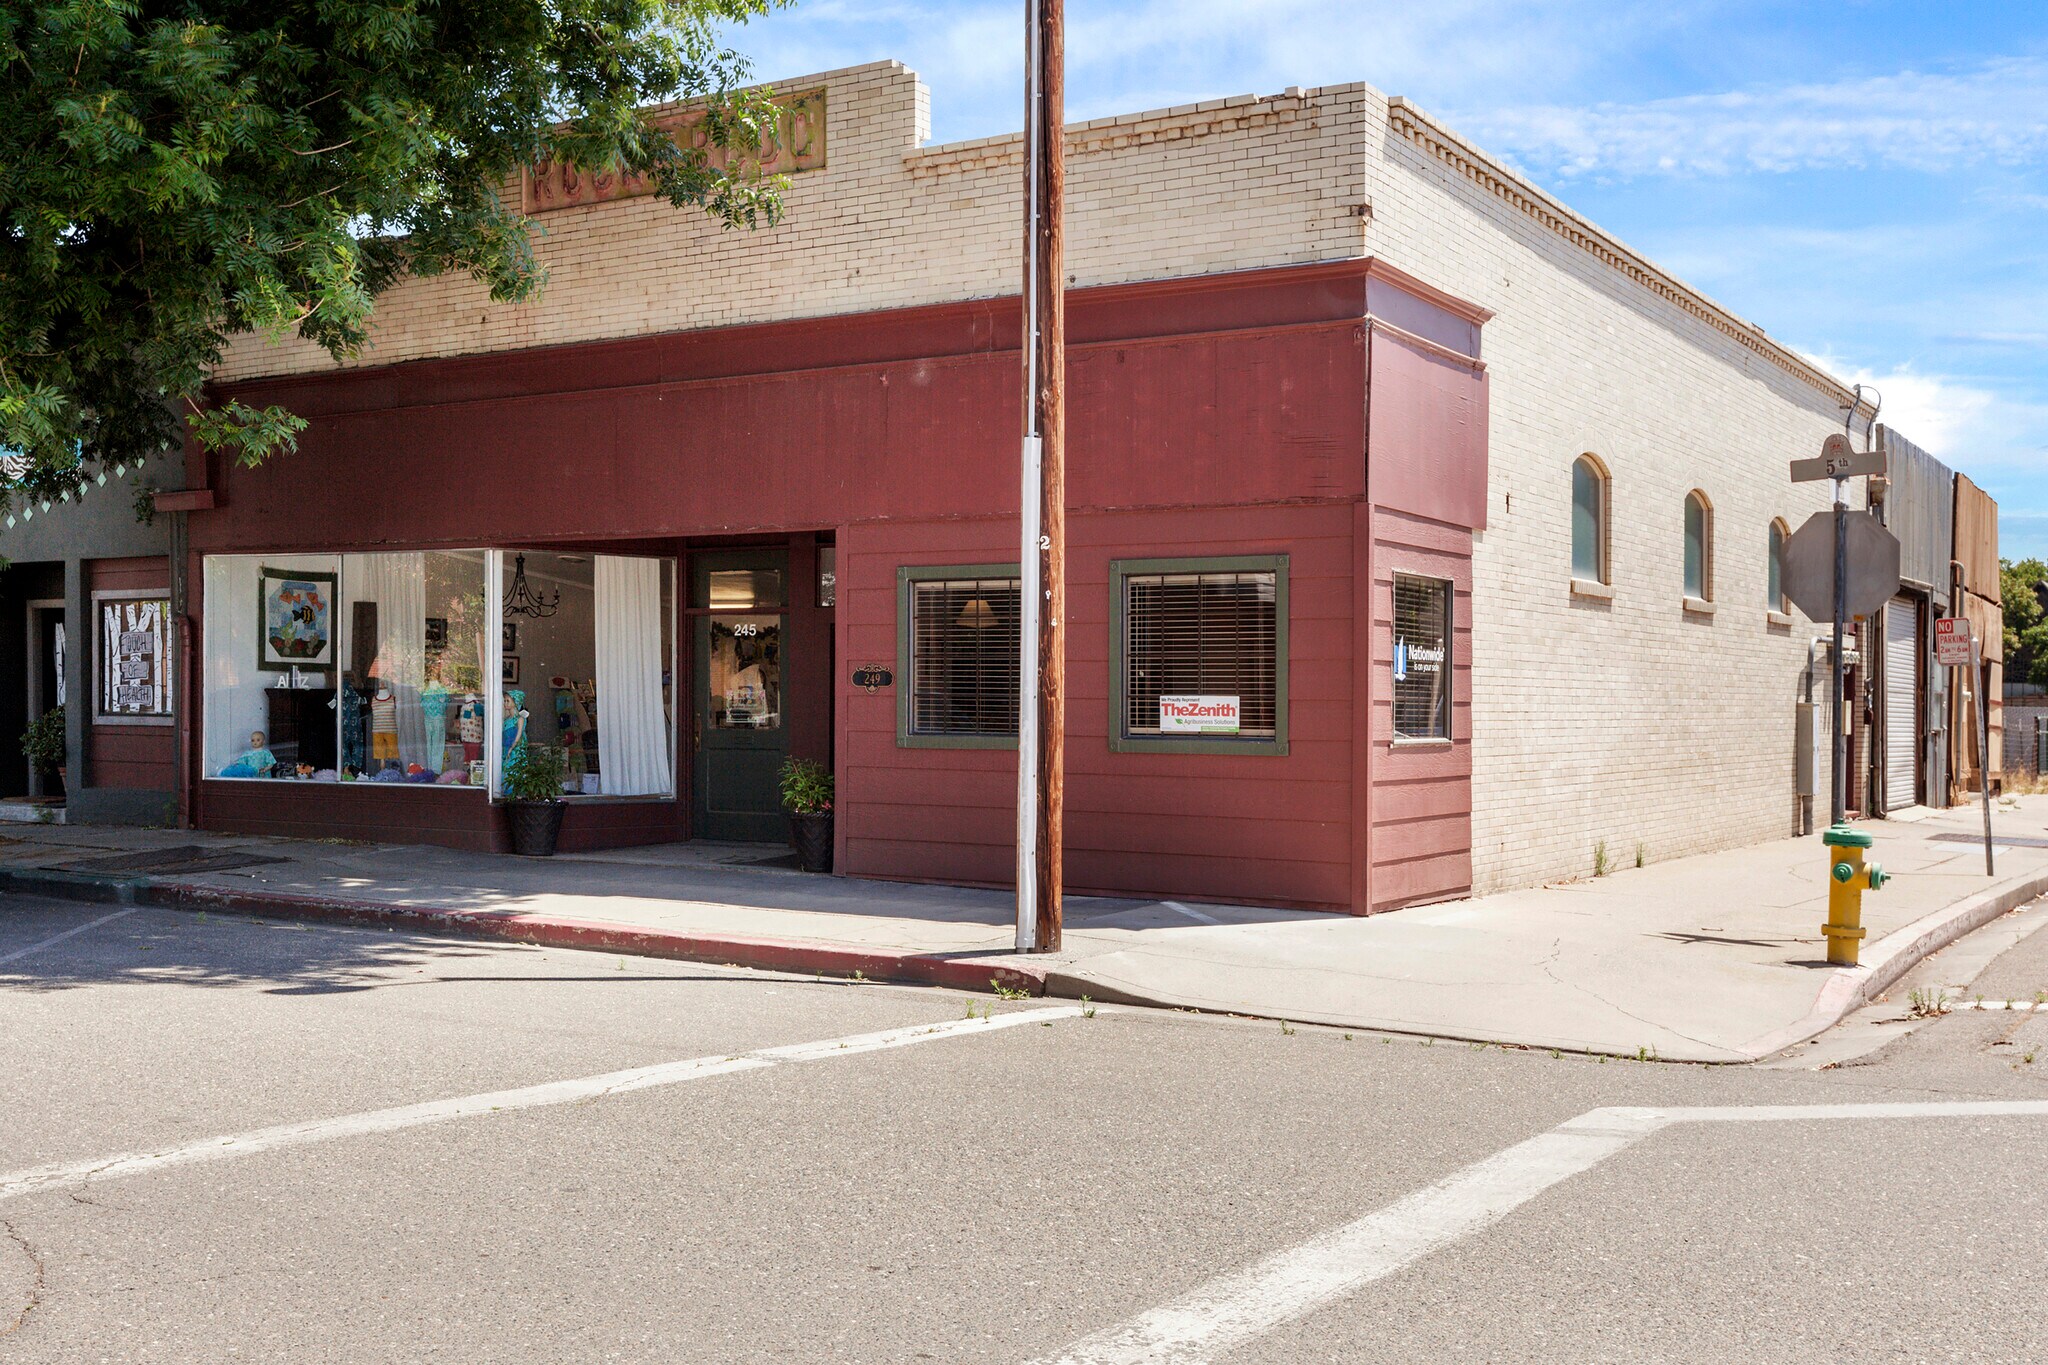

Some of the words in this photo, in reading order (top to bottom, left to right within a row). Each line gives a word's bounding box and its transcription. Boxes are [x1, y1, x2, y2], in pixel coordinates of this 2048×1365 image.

[1040, 535, 1051, 550] 2
[734, 624, 757, 636] 245
[1938, 621, 1952, 632] NO
[1940, 635, 1968, 644] PARKING
[1408, 644, 1445, 661] Nationwide
[1423, 664, 1431, 673] your
[864, 673, 880, 685] 249
[1161, 703, 1236, 717] TheZenith
